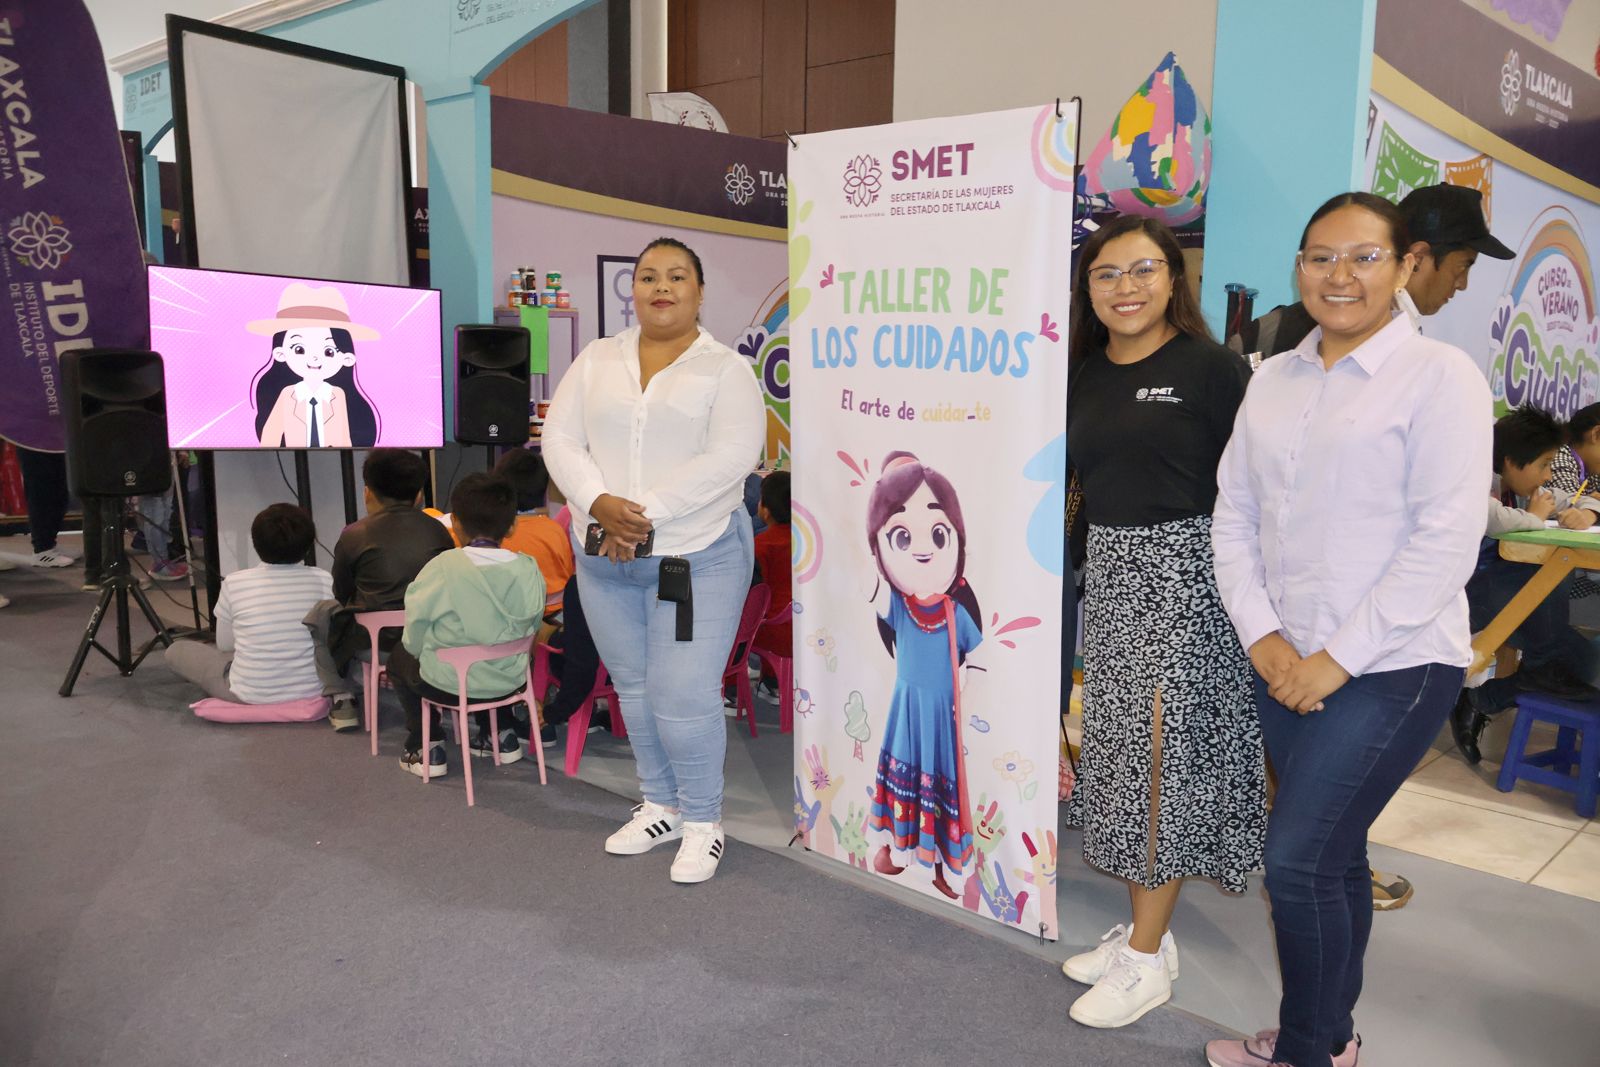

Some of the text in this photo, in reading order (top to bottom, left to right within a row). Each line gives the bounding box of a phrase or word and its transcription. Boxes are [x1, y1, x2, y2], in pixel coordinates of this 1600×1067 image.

[140, 72, 162, 96] IDET
[1525, 63, 1573, 109] TLAXCALA
[891, 142, 974, 181] SMET
[890, 184, 1014, 203] SECRETARÍA DE LAS MUJERES
[890, 200, 1001, 216] DEL ESTADO DE TLAXCALA
[837, 267, 1009, 316] TALLER DE
[1538, 266, 1567, 296] CURSO
[9, 283, 35, 358] DE TLAXCALA
[41, 279, 95, 364] ID
[1542, 292, 1579, 322] VERANO
[23, 281, 60, 415] INSTITUTO DEL DEPORTE
[811, 324, 1036, 378] LOS CUIDADOS
[1149, 387, 1174, 395] SMET
[1505, 328, 1582, 418] Ciudad
[841, 389, 853, 411] El
[859, 398, 890, 418] arte
[897, 401, 915, 420] de
